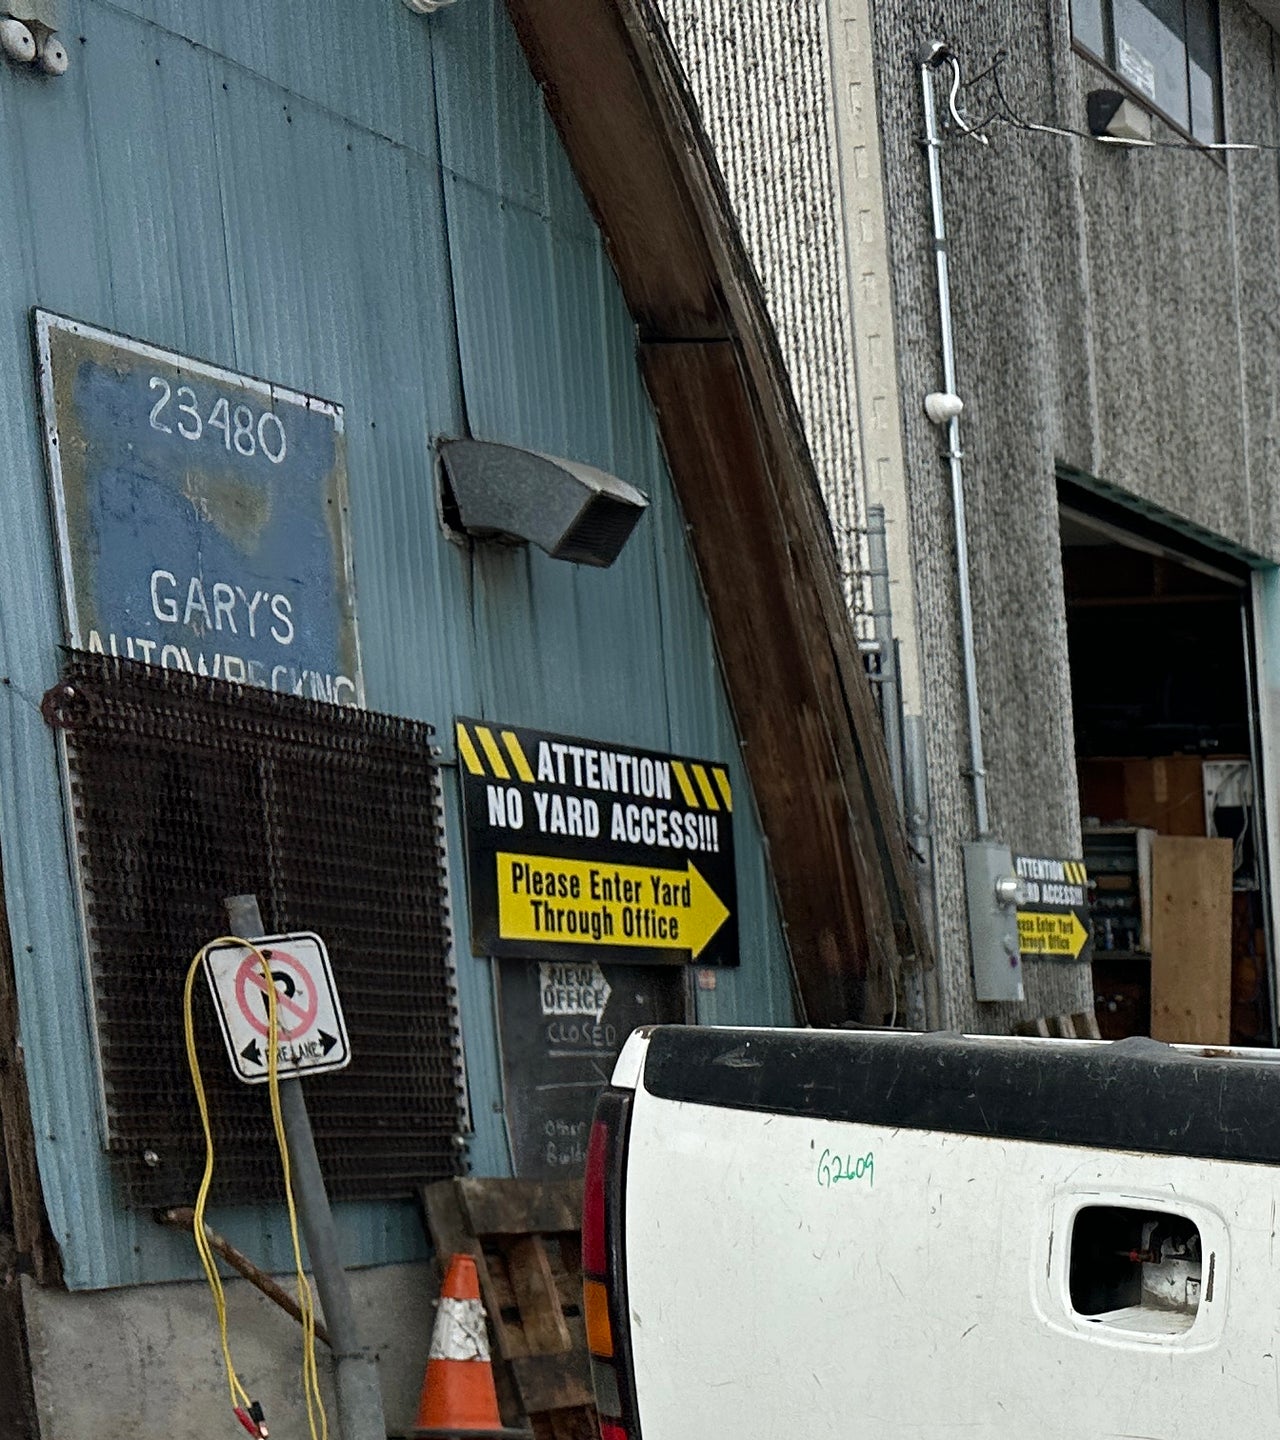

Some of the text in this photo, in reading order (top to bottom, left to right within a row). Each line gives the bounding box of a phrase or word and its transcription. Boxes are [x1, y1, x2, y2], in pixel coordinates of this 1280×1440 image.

[150, 377, 287, 463] 23480
[151, 569, 295, 645] GARY'S
[538, 741, 672, 800] ATTENTION
[486, 785, 719, 852] NO YARD ACCESS!!!
[511, 861, 691, 908] Please Enter Yard
[1016, 857, 1065, 882] ATTENTION
[530, 900, 679, 940] Through Office
[544, 985, 604, 1010] OFFICE
[548, 1022, 617, 1047] CLOSED
